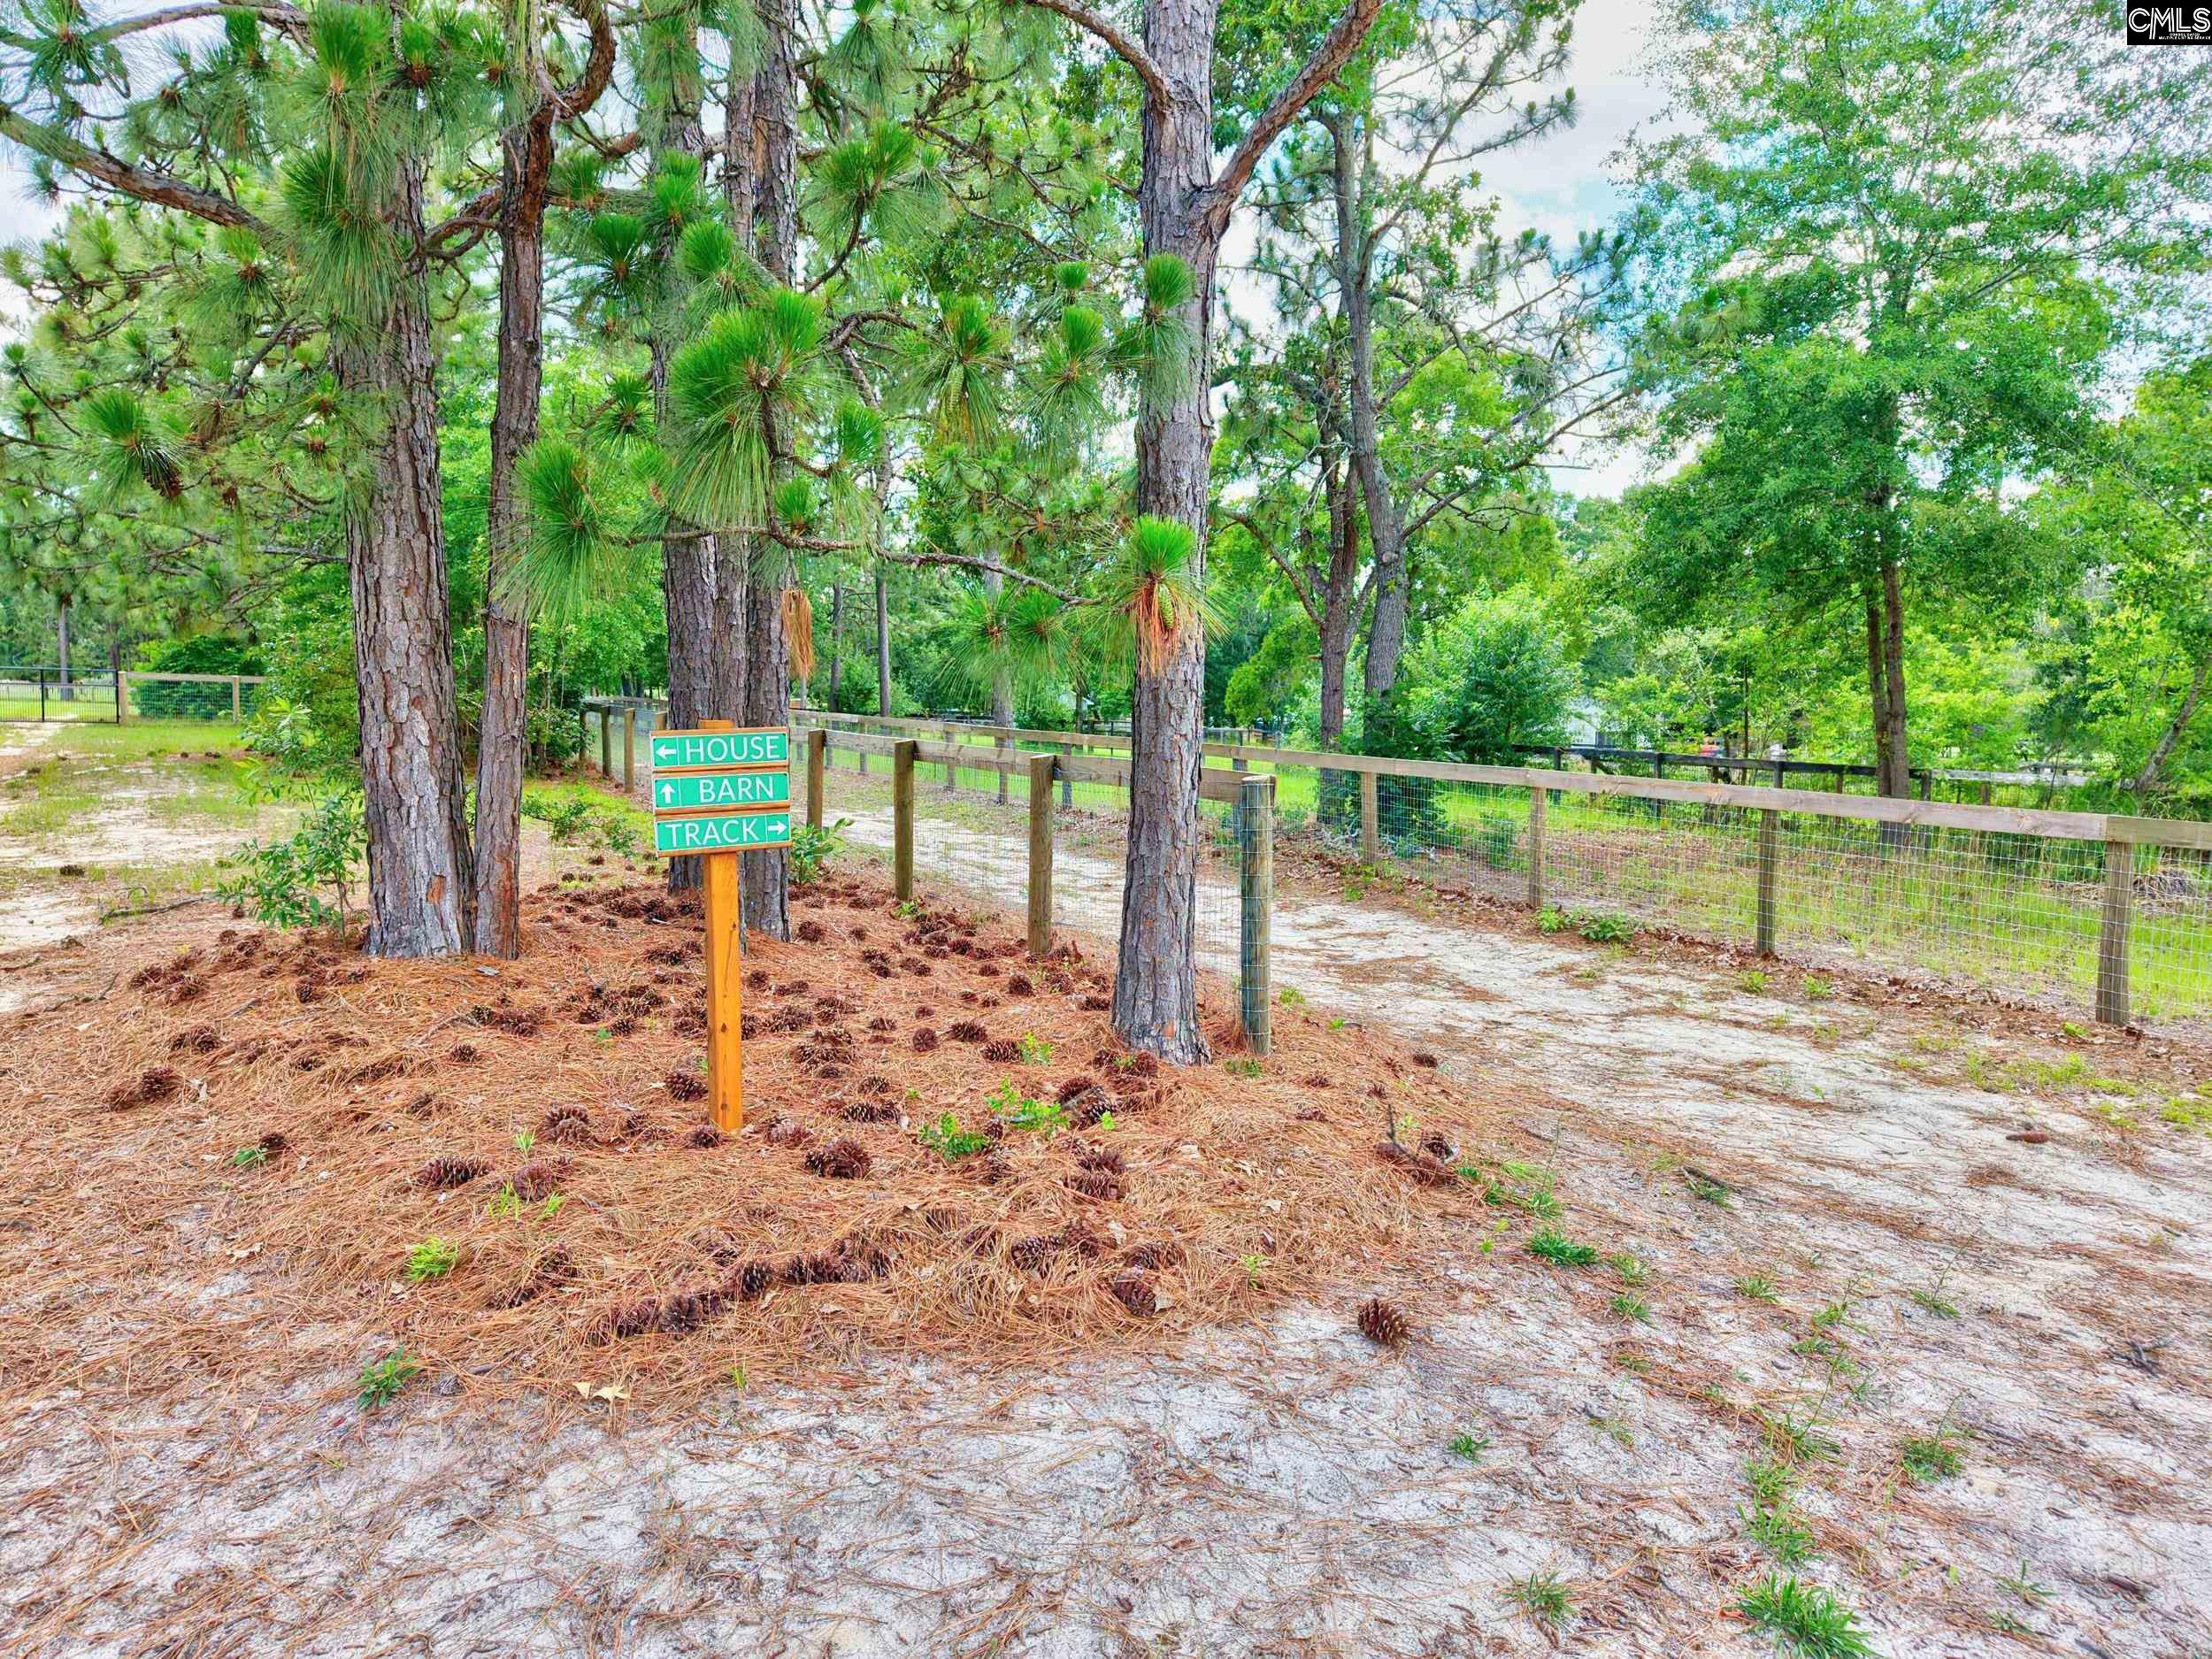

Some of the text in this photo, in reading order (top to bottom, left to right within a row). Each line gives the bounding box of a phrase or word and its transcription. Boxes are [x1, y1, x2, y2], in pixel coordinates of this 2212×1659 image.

[685, 735, 780, 763] HOUSE
[699, 776, 774, 803] BARN
[665, 818, 759, 847] TRACK
